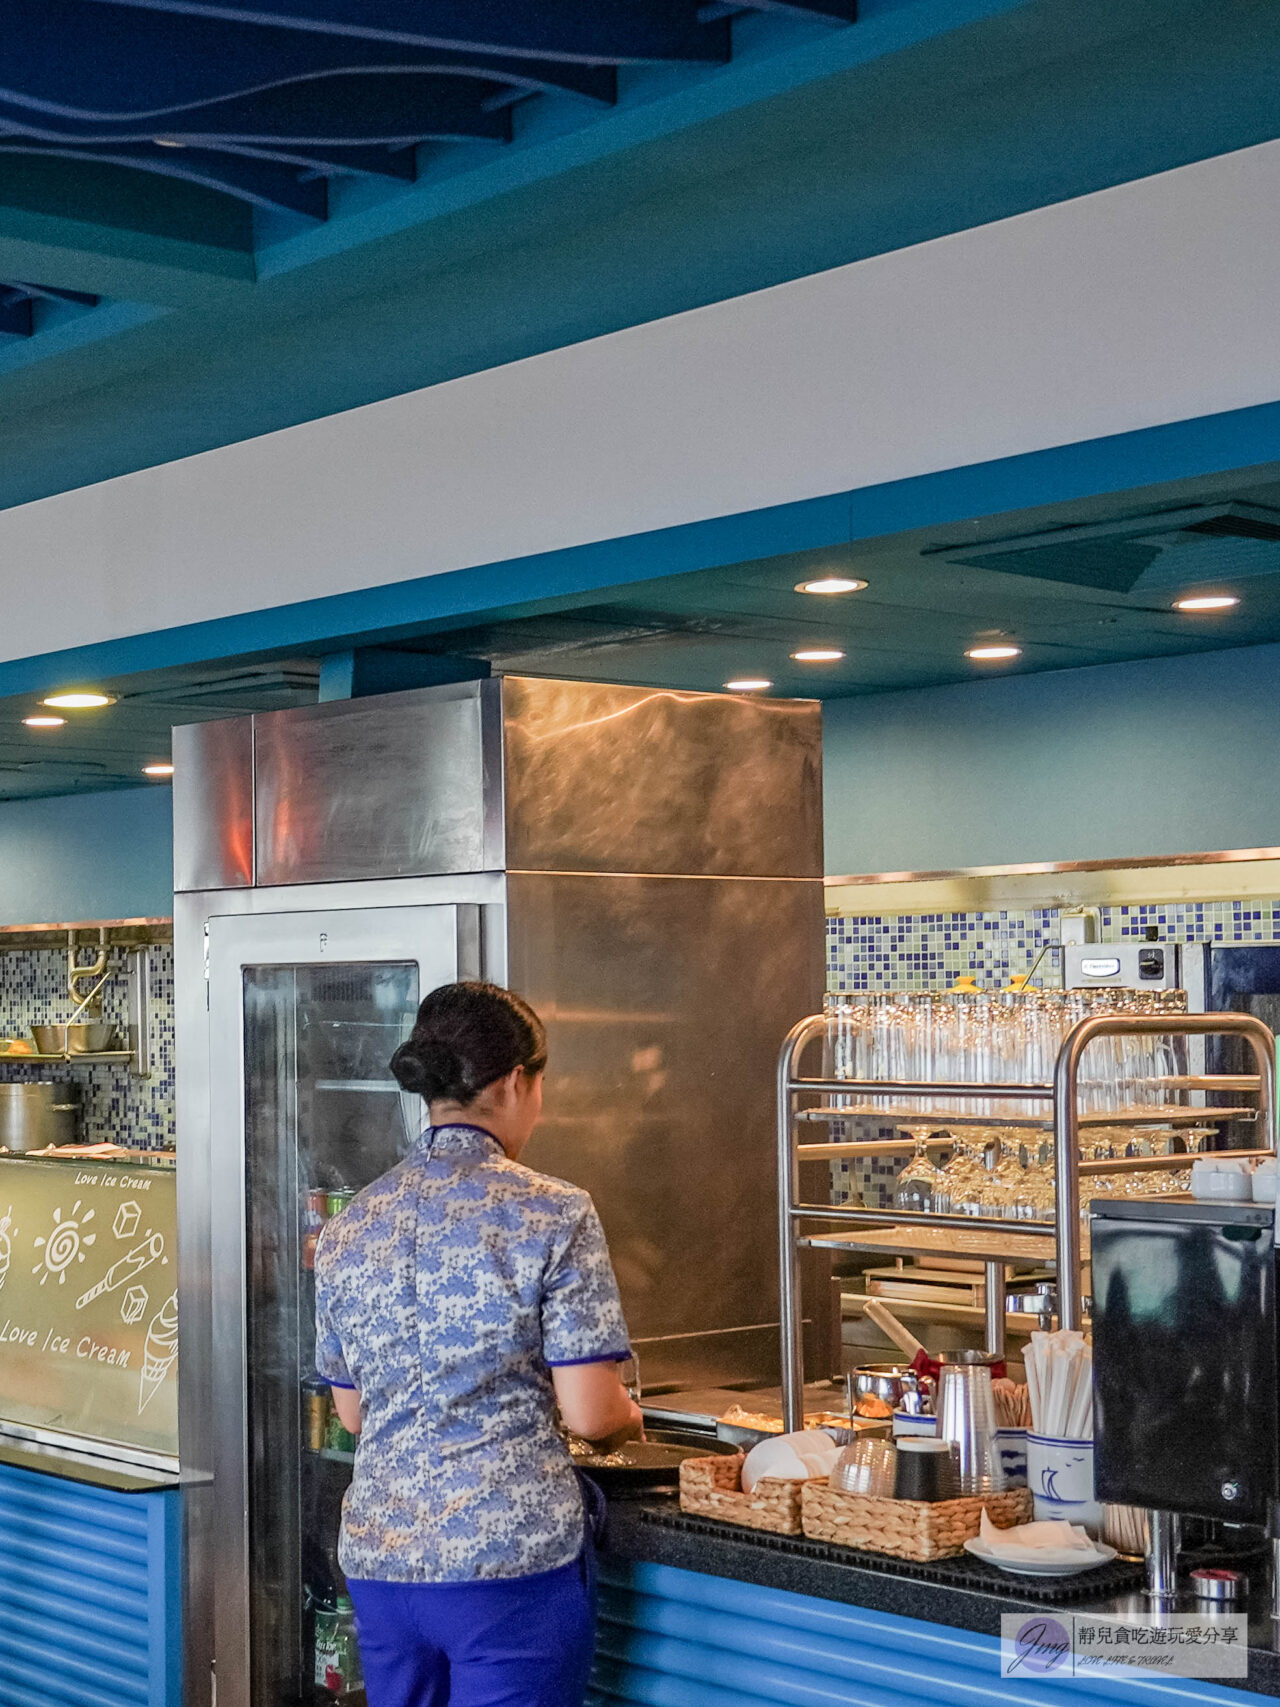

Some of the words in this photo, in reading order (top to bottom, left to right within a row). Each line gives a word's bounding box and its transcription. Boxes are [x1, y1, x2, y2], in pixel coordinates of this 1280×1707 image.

[74, 1172, 98, 1185] Love
[100, 1173, 117, 1187] Ice
[120, 1175, 152, 1191] Cream
[0, 1319, 38, 1346] Love
[42, 1328, 71, 1353] Ice
[76, 1336, 131, 1368] Cream
